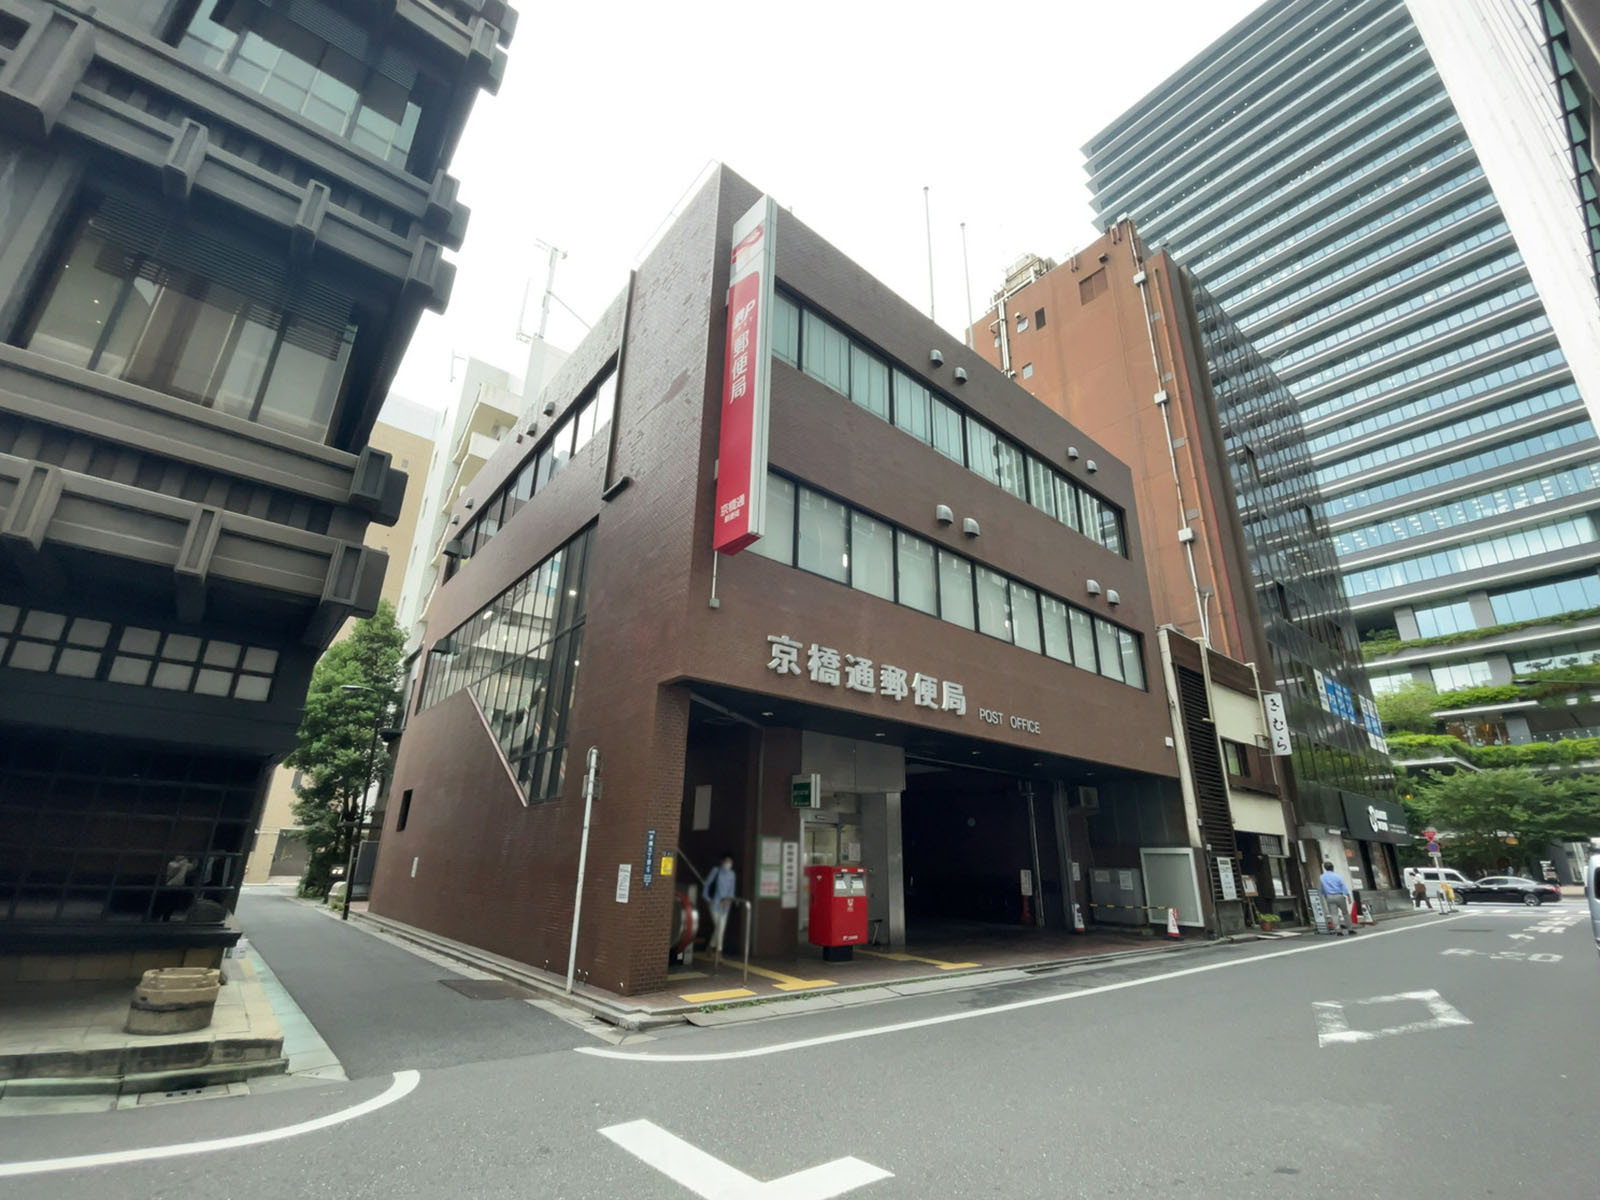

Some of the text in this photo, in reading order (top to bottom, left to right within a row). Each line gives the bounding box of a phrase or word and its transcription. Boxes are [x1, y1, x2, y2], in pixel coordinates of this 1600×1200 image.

[729, 329, 750, 405] 郵便局
[767, 635, 966, 715] 京橋通郵便局
[979, 708, 1041, 735] POST OFFICE
